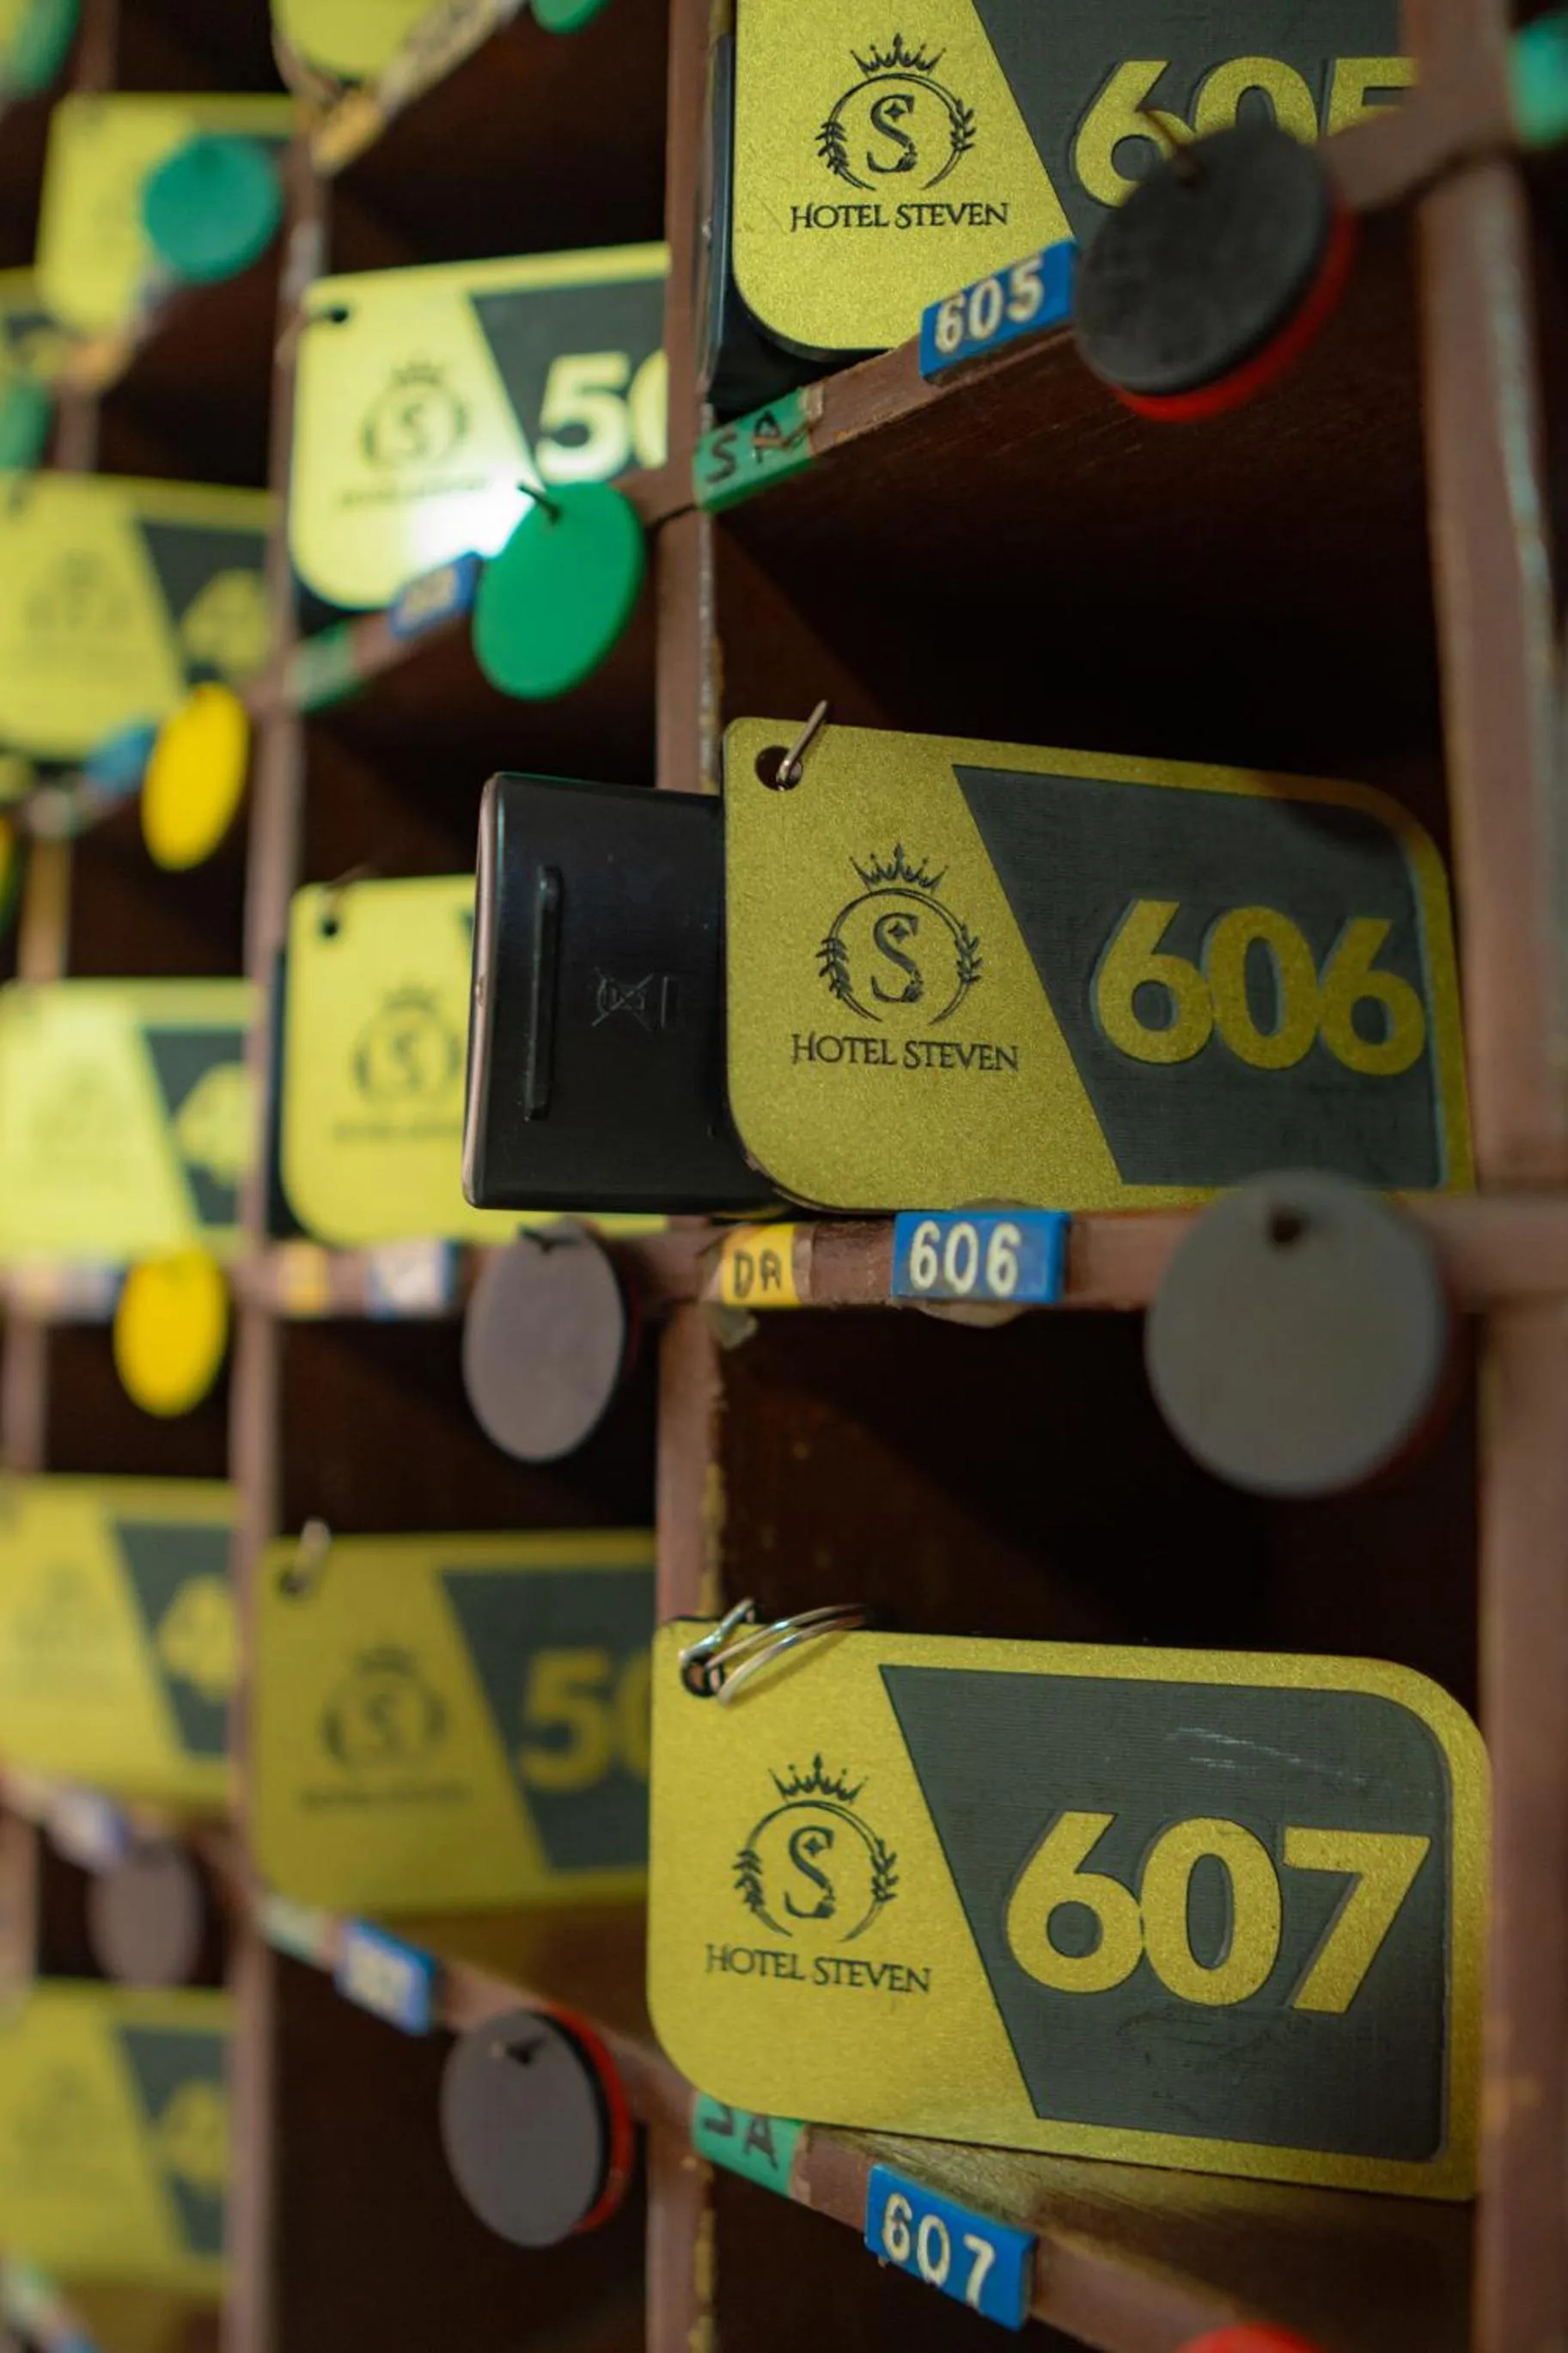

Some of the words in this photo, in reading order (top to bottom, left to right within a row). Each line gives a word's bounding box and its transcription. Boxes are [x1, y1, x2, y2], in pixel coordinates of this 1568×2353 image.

[867, 94, 918, 173] S
[790, 202, 889, 232] HOTEL
[895, 202, 1010, 229] STEVEN
[935, 259, 1044, 354] 605
[870, 912, 924, 1003] S
[1097, 899, 1426, 1077] 606
[791, 1032, 897, 1066] HOTEL
[904, 1040, 1020, 1072] STEVEN
[732, 1248, 782, 1299] DA
[909, 1219, 1022, 1297] 606
[784, 1824, 837, 1919] S
[1006, 1811, 1431, 2014] 607
[705, 1943, 806, 1981] HOTEL
[813, 1956, 931, 1994] STEVEN
[882, 2192, 995, 2308] 607
